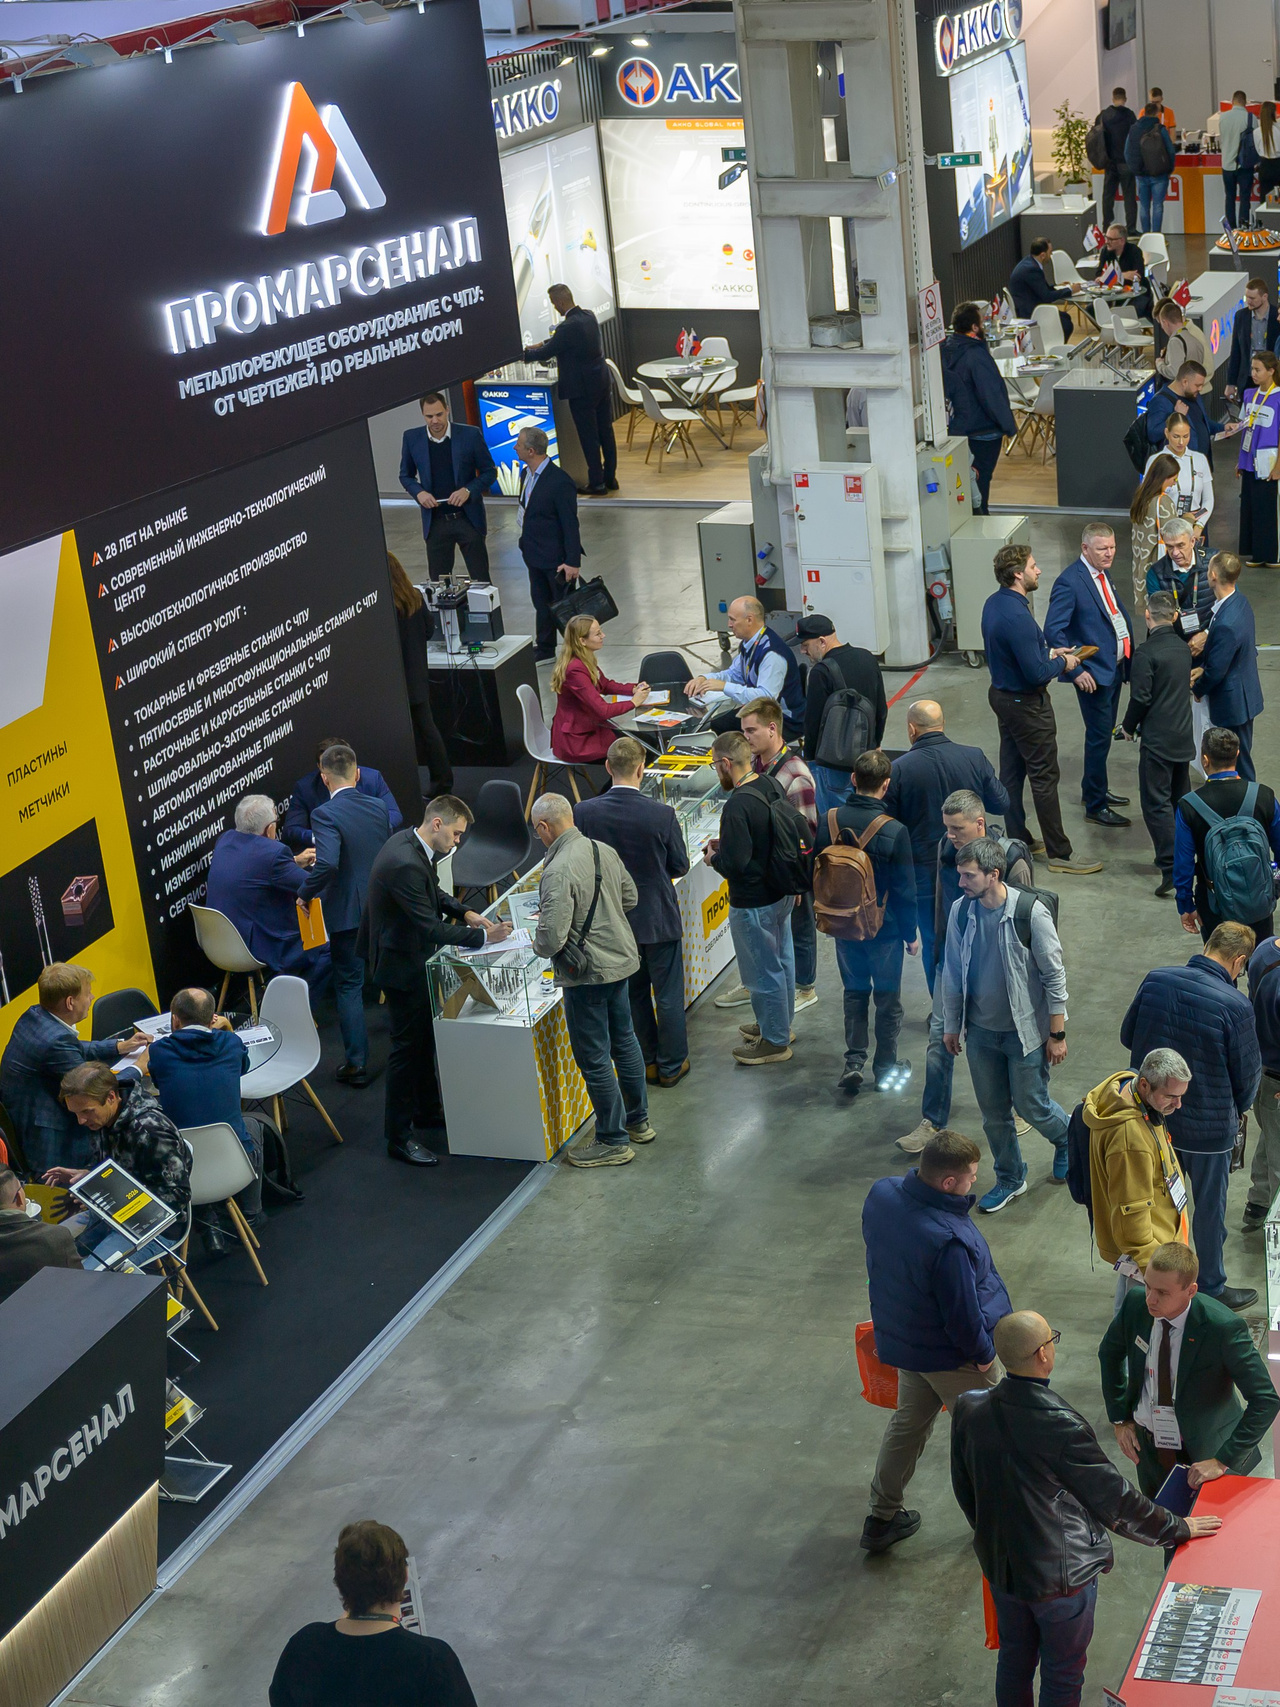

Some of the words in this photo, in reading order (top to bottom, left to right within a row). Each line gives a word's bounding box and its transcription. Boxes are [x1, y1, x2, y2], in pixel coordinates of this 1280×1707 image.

[953, 0, 1002, 59] AKKO
[165, 216, 483, 355] ПРОМАРСЕНАЛ
[178, 335, 327, 399] МЕТАЛЛОРЕЖУЩЕЕ
[328, 300, 441, 350] ОБОРУДОВАНИЕ
[441, 296, 453, 314] С
[453, 285, 485, 310] ЧПУ:
[214, 393, 236, 417] ОТ
[238, 362, 320, 408] ЧЕРТЕЖЕЙ
[320, 358, 344, 385] ДО
[345, 333, 421, 373] РЕАЛЬНЫХ
[421, 318, 463, 346] ФОРМ
[104, 543, 118, 560] 28
[119, 531, 138, 554] ЛЕТ
[138, 524, 155, 545] НА
[155, 506, 188, 537] РЫНКЕ
[110, 538, 185, 591] СОВРЕМЕННЫЙ
[186, 464, 327, 553] ИНЖЕНЕРНО-ТЕХНОЛОГИЧЕСКИЙ
[113, 583, 147, 613] ЦЕНТР
[120, 569, 240, 647] ВЫСОКОТЕХНОЛОГИЧНОЕ
[240, 531, 309, 578] ПРОИЗВОДСТВО
[125, 641, 177, 683] ШИРОКИЙ
[177, 620, 213, 653] СПЕКТР
[213, 604, 242, 631] УСЛУГ
[134, 681, 187, 724] ТОКАРНЫЕ
[187, 676, 196, 690] И
[196, 647, 251, 687] ФРЕЗЕРНЫЕ
[250, 627, 285, 656] СТАНКИ
[285, 620, 293, 633] С
[292, 608, 310, 627] ЧПУ
[138, 701, 204, 750] ПЯТИОСЕВЫЕ
[204, 694, 212, 709] И
[212, 626, 324, 702] МНОГОФУНКЦИОНАЛЬНЫЕ
[323, 608, 356, 635] СТАНКИ
[355, 601, 363, 614] С
[362, 590, 379, 611] ЧПУ
[143, 730, 200, 774] РАСТОЧНЫЕ
[201, 725, 209, 739] И
[210, 685, 273, 736] КАРУСЕЛЬНЫЕ
[273, 664, 308, 695] СТАНКИ
[307, 656, 315, 669] С
[314, 644, 332, 666] ЧПУ
[147, 710, 271, 799] ШЛИФОВАЛЬНО-ЗАТОЧНЫЕ
[271, 688, 305, 717] СТАНКИ
[305, 682, 312, 696] С
[312, 671, 329, 692] ЧПУ
[7, 741, 69, 787] ПЛАСТИНЫ
[18, 781, 71, 823] МЕТЧИКИ
[152, 743, 263, 824] АВТОМАТИЗИРОВАННЫЕ
[263, 720, 294, 748] ЛИНИИ
[156, 806, 207, 846] ОСНАСТКА
[207, 800, 216, 814] И
[216, 758, 274, 807] ИНСТРУМЕНТ
[160, 816, 226, 872] ИНЖИНИРИНГ
[164, 850, 214, 895] ИЗМЕРИТЕ
[125, 1188, 139, 1201] 2026
